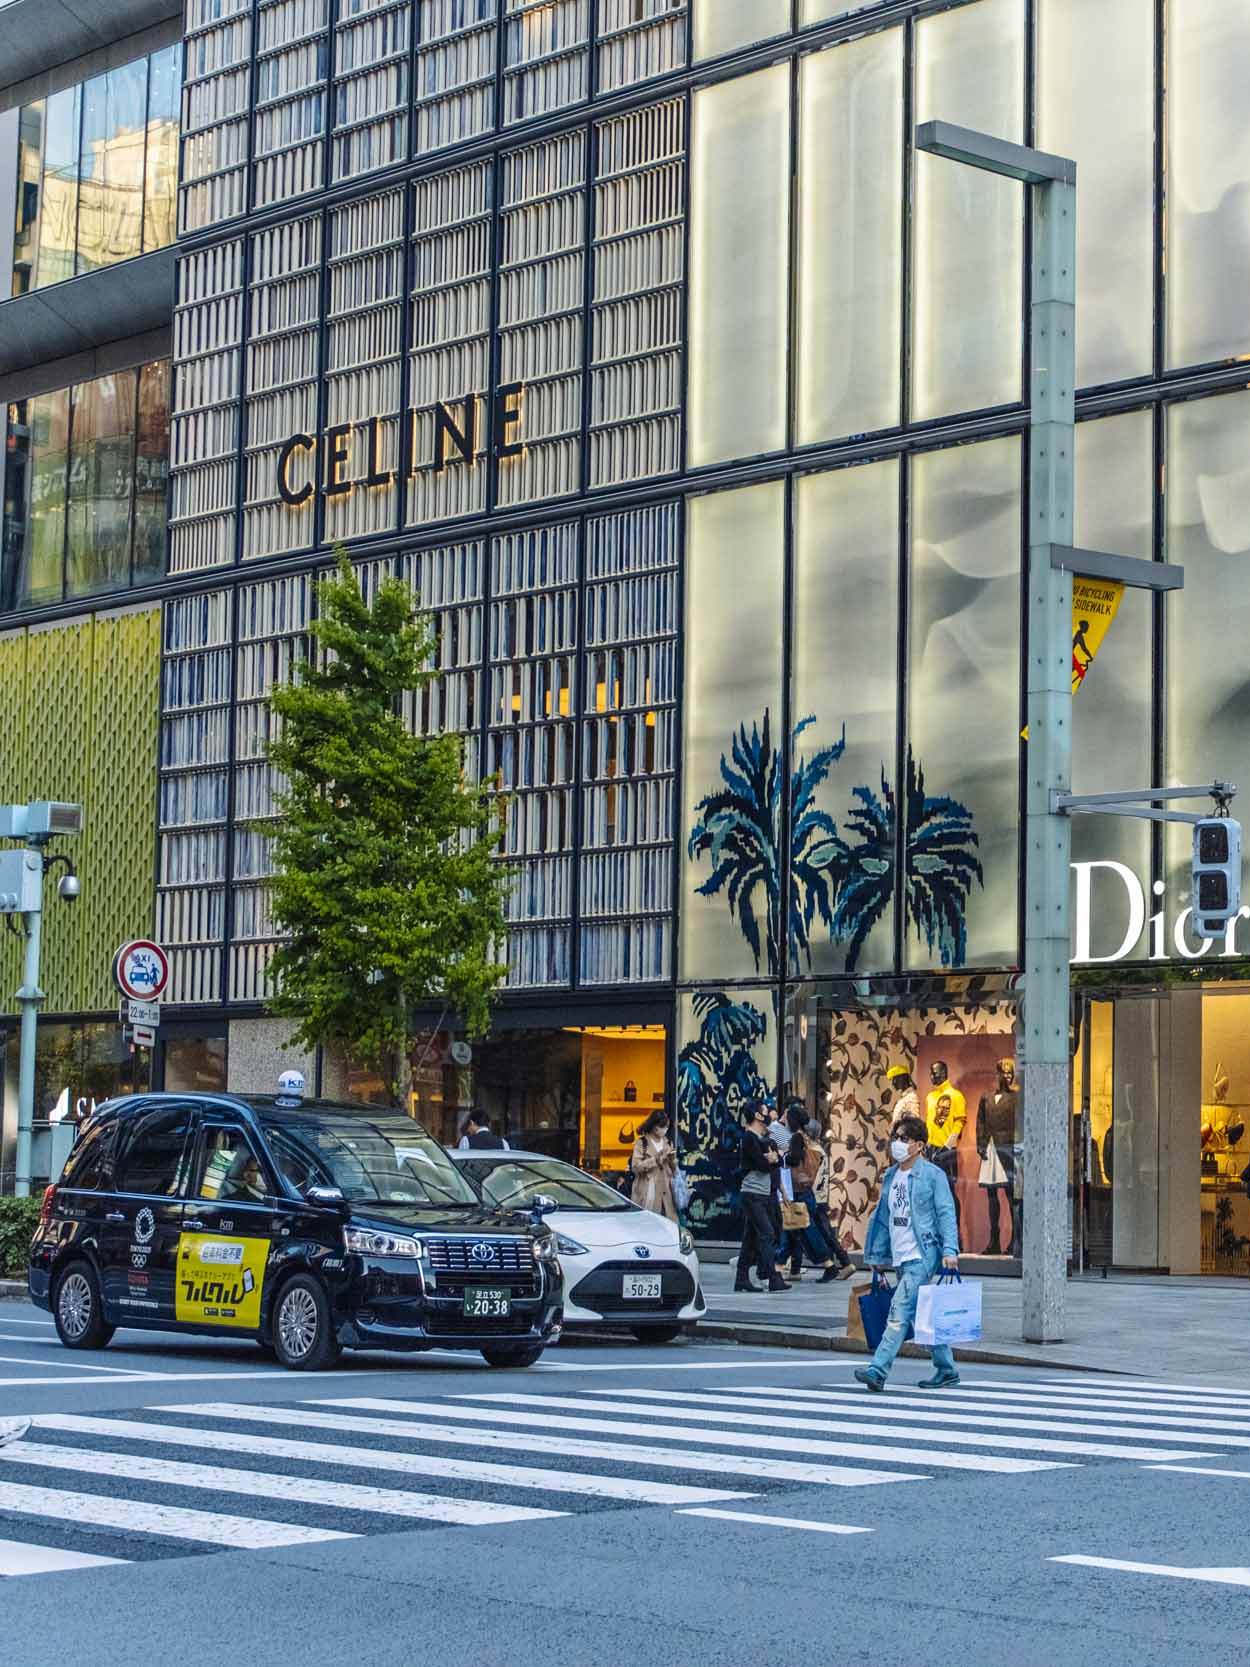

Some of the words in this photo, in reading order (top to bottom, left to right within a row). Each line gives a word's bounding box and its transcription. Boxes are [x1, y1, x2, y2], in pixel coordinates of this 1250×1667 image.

[277, 381, 524, 506] CELINE
[1074, 599, 1112, 615] SIDEWALK
[1069, 861, 1250, 963] Dior
[632, 1284, 659, 1297] 50-29
[474, 1300, 508, 1315] 20-38
